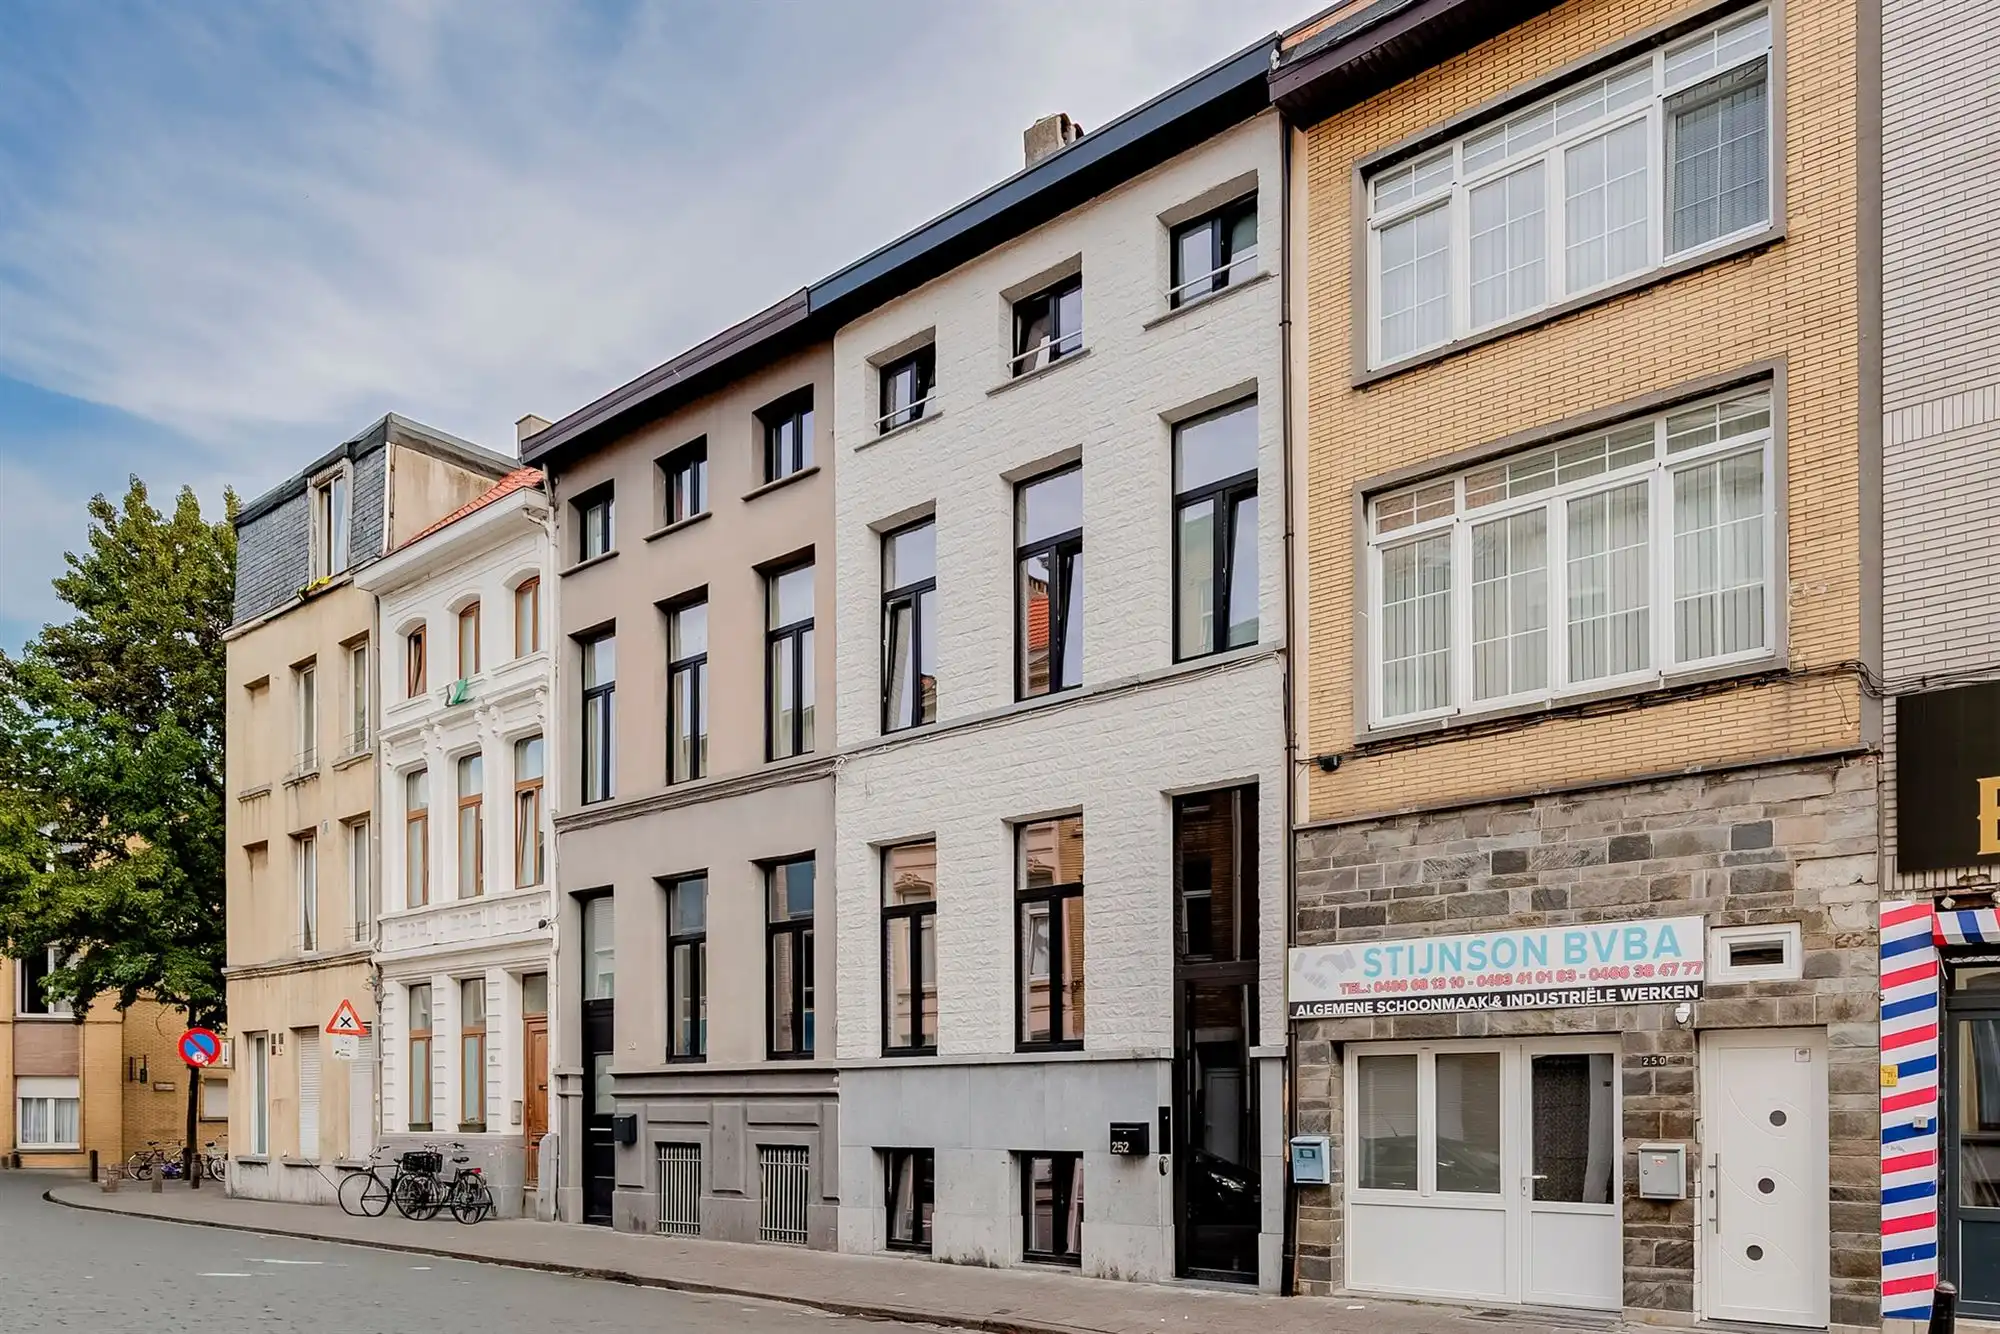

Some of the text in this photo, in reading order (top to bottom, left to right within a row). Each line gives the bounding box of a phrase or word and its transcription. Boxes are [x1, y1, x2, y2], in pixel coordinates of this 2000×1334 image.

[1363, 924, 1682, 977] STIJNSON BVBA
[1682, 960, 1704, 975] 77
[1296, 984, 1698, 1016] ALGEMENE SCHOONMAAK & INDUSTRIËLE WERKEN
[1642, 1056, 1666, 1066] 250
[1112, 1141, 1129, 1153] 252
